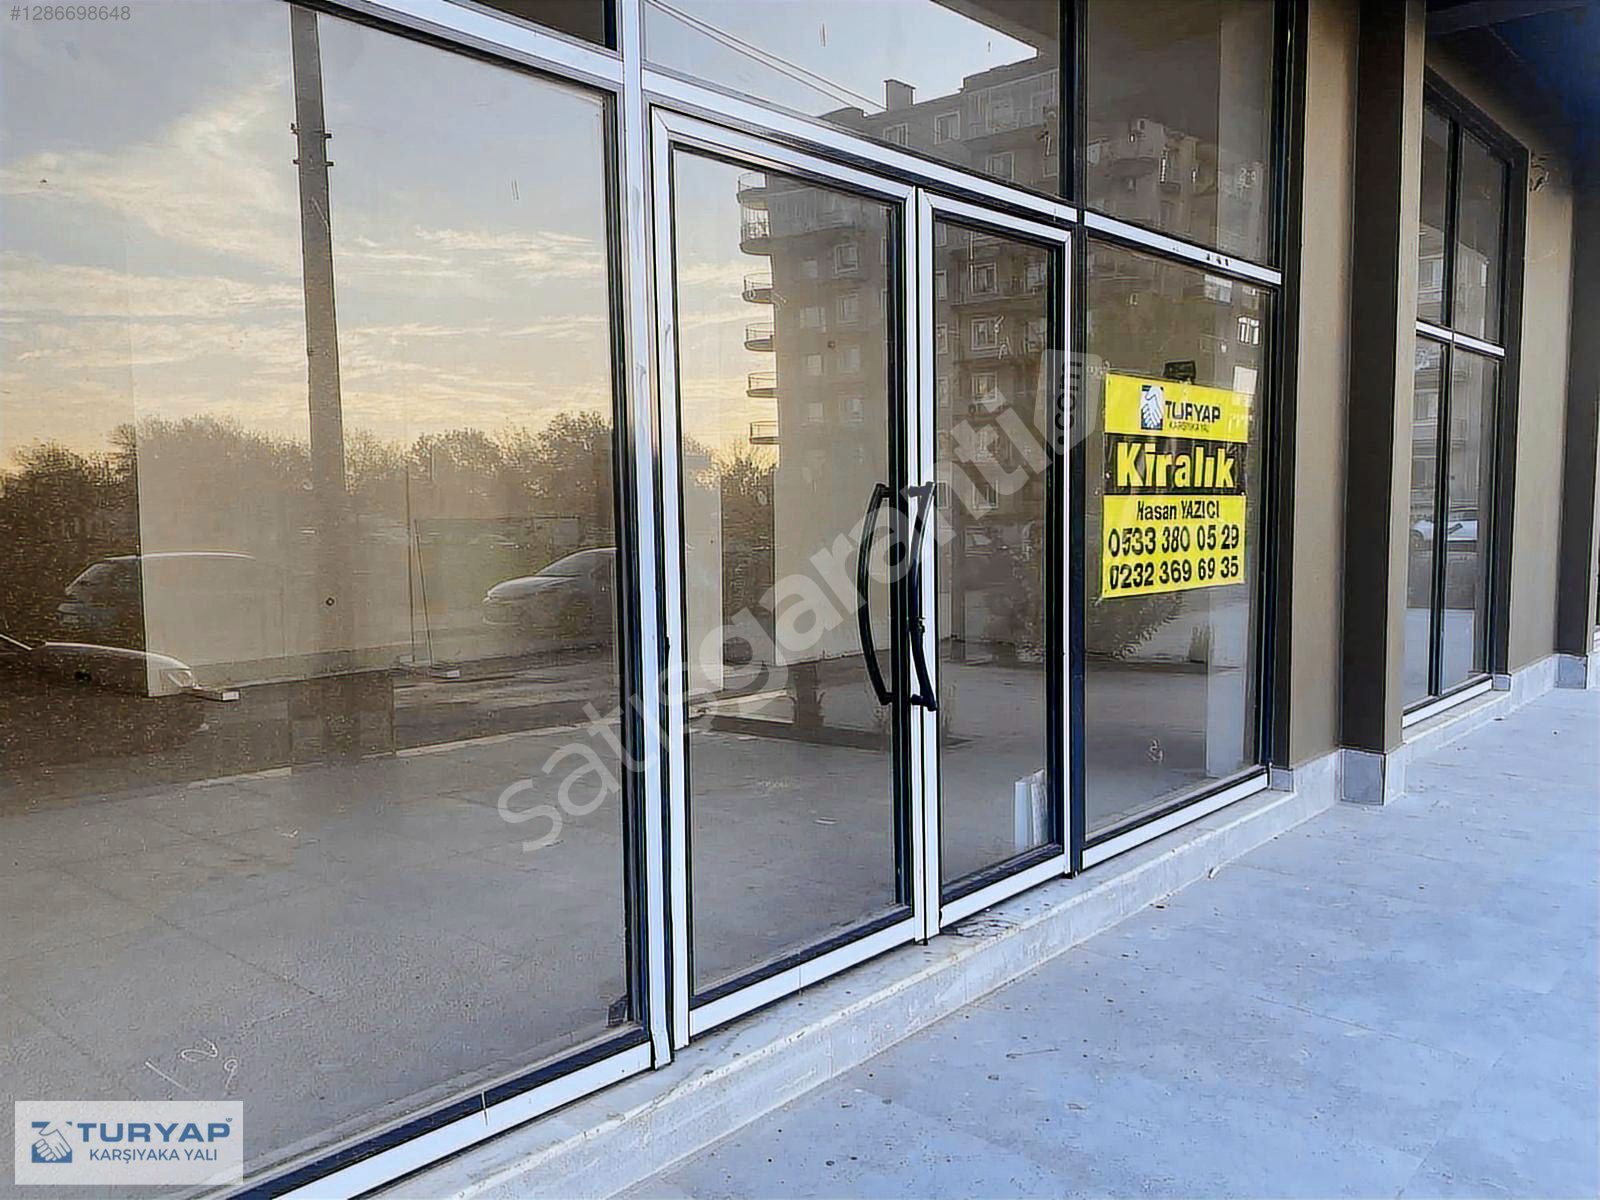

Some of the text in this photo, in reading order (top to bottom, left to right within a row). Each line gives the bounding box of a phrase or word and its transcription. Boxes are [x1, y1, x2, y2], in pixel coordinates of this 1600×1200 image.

[1165, 400, 1221, 423] TURYAP
[1117, 442, 1235, 488] Kiralık
[1137, 501, 1220, 520] Hasan YAZICI
[1108, 524, 1239, 557] 0533 380 05 29
[1110, 555, 1239, 589] 0232 369 69 35
